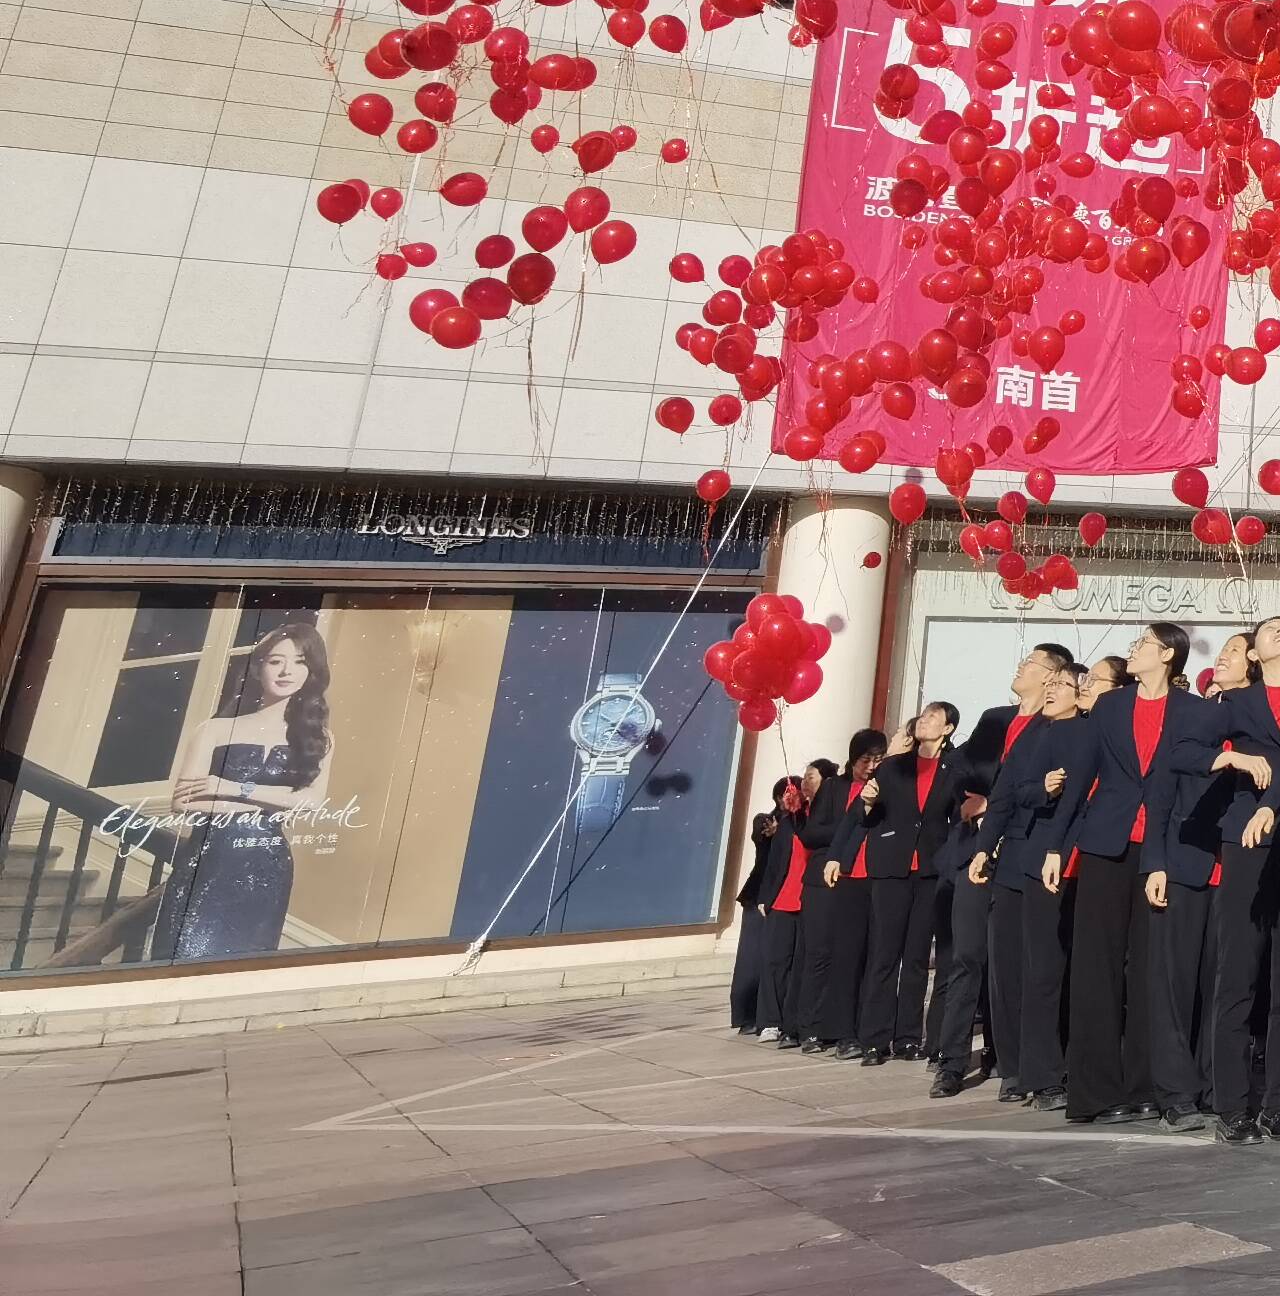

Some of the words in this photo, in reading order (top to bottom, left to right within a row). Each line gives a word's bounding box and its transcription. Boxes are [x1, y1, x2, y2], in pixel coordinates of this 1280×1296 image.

[996, 367, 1082, 414] 南首
[357, 513, 531, 539] LONGINES
[1050, 576, 1205, 615] OMEGA
[99, 796, 210, 859] Elegance
[211, 810, 233, 830] is
[236, 808, 267, 831] an
[268, 794, 369, 829] attitude
[232, 835, 284, 849] 优雅态度
[291, 832, 340, 845] 真我个性
